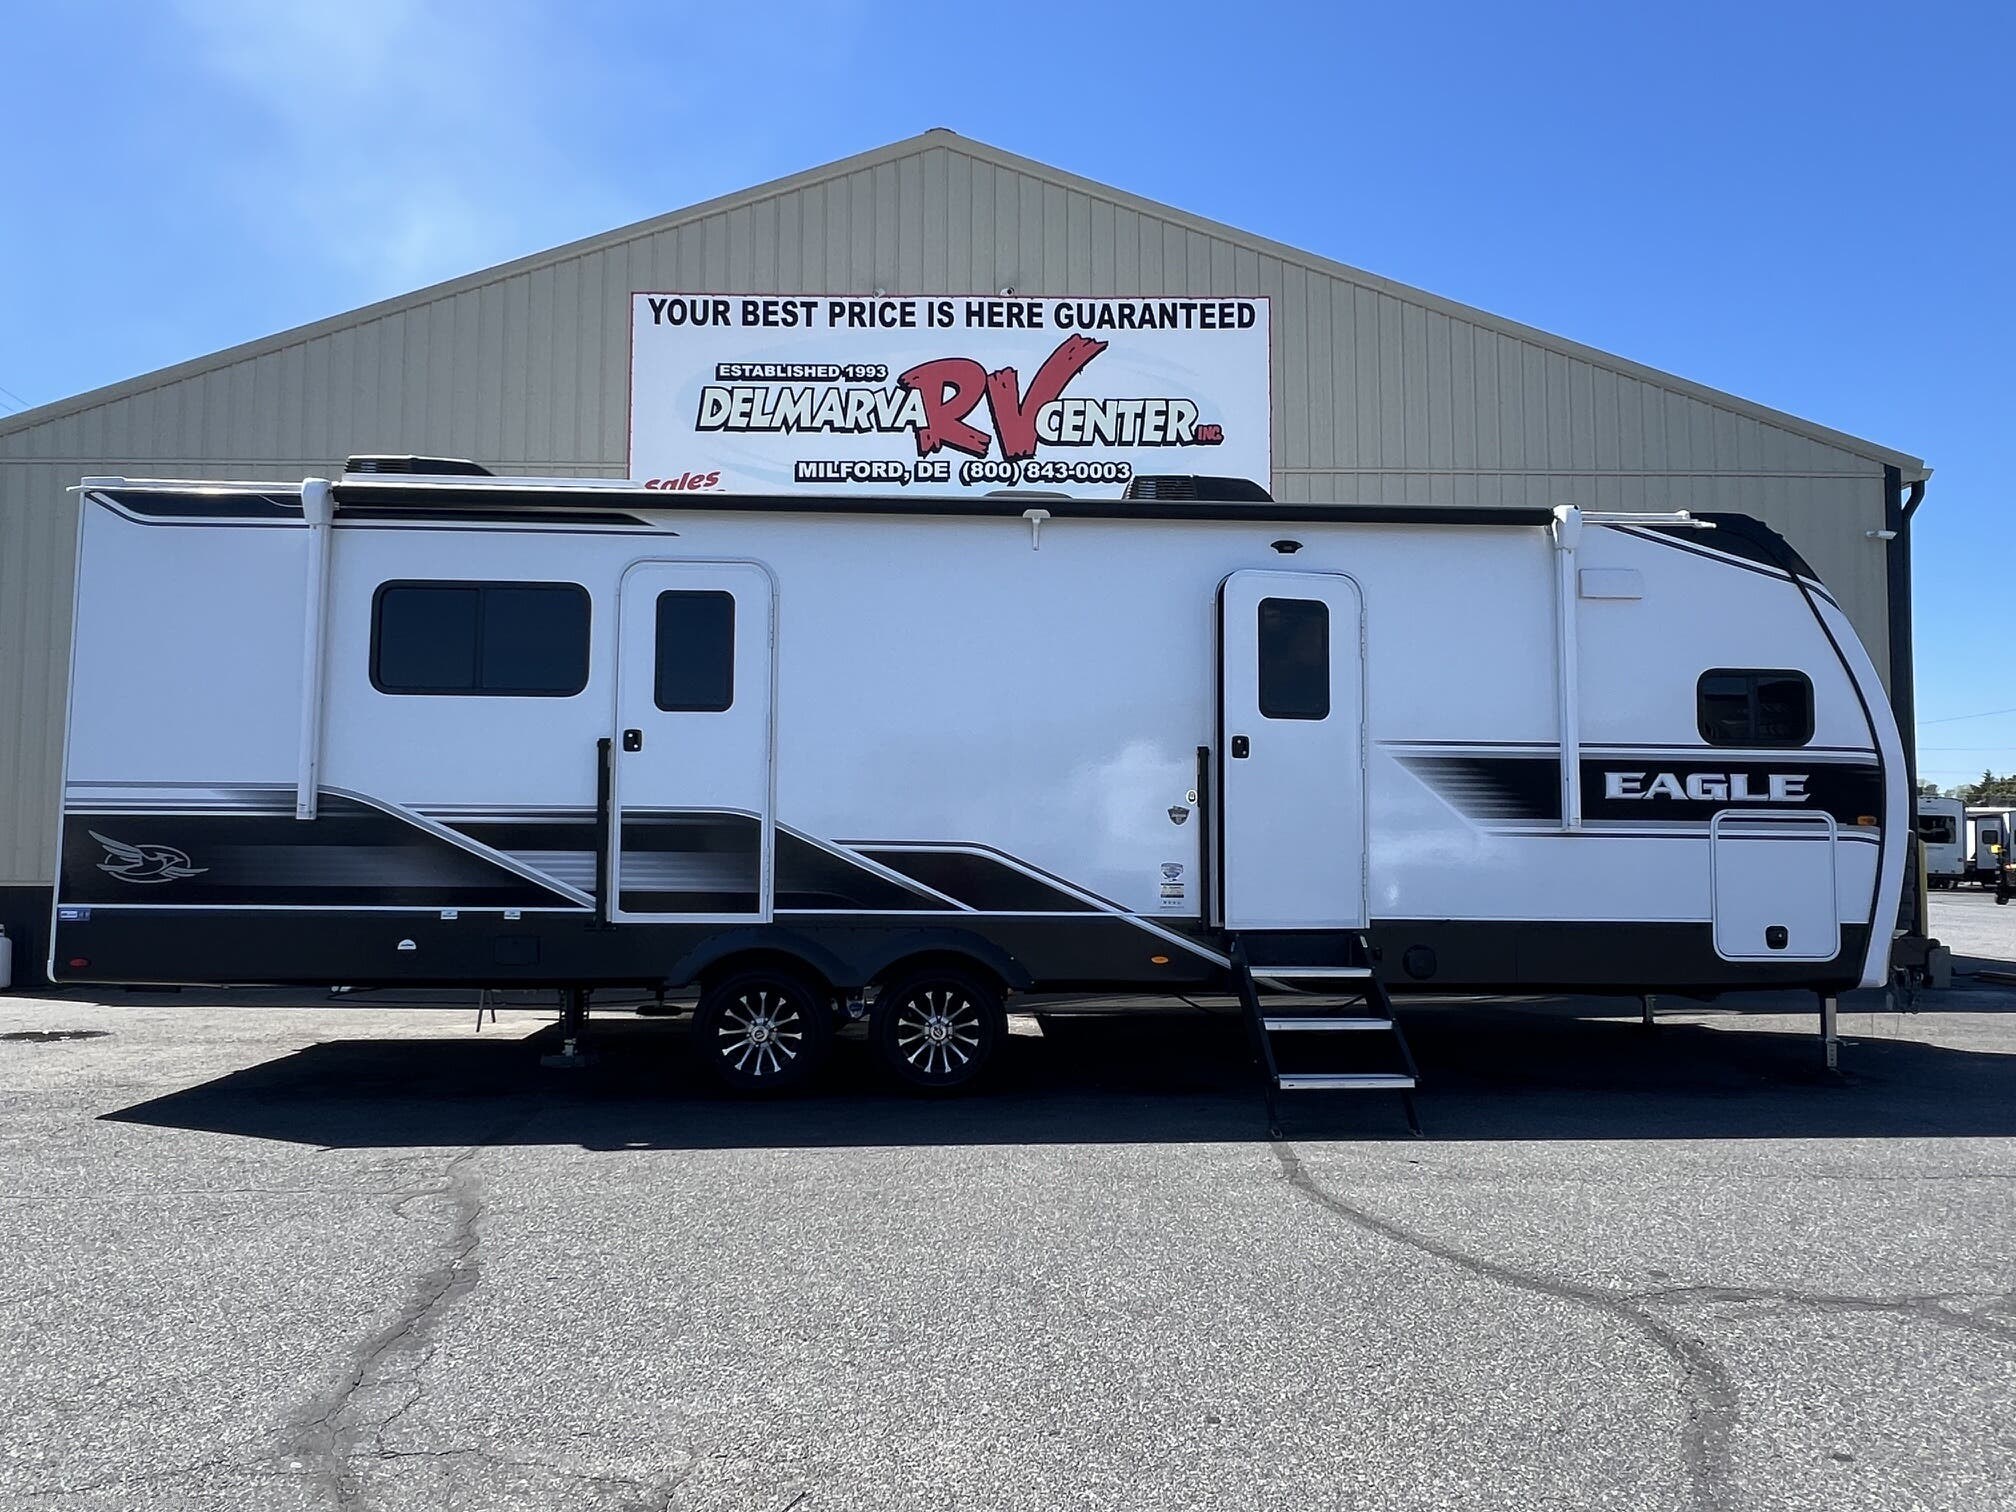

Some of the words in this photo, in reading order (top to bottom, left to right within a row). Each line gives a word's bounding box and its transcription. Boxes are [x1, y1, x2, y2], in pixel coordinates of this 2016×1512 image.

[648, 298, 731, 326] YOUR
[742, 300, 818, 328] BEST
[829, 301, 916, 328] PRICE
[927, 302, 954, 328] IS
[965, 302, 1043, 328] HERE
[1054, 302, 1256, 329] GUARANTEED
[717, 363, 842, 380] ESTABLISHED
[844, 364, 888, 380] 1993
[696, 387, 930, 433] DELMARVA
[897, 333, 1109, 462] RV
[1035, 399, 1198, 446] CENTER
[796, 461, 910, 485] MILFORD,
[915, 461, 950, 482] DE
[960, 462, 1020, 485] (800)
[1024, 463, 1132, 483] 843-0003
[1604, 772, 1811, 802] EAGLE
